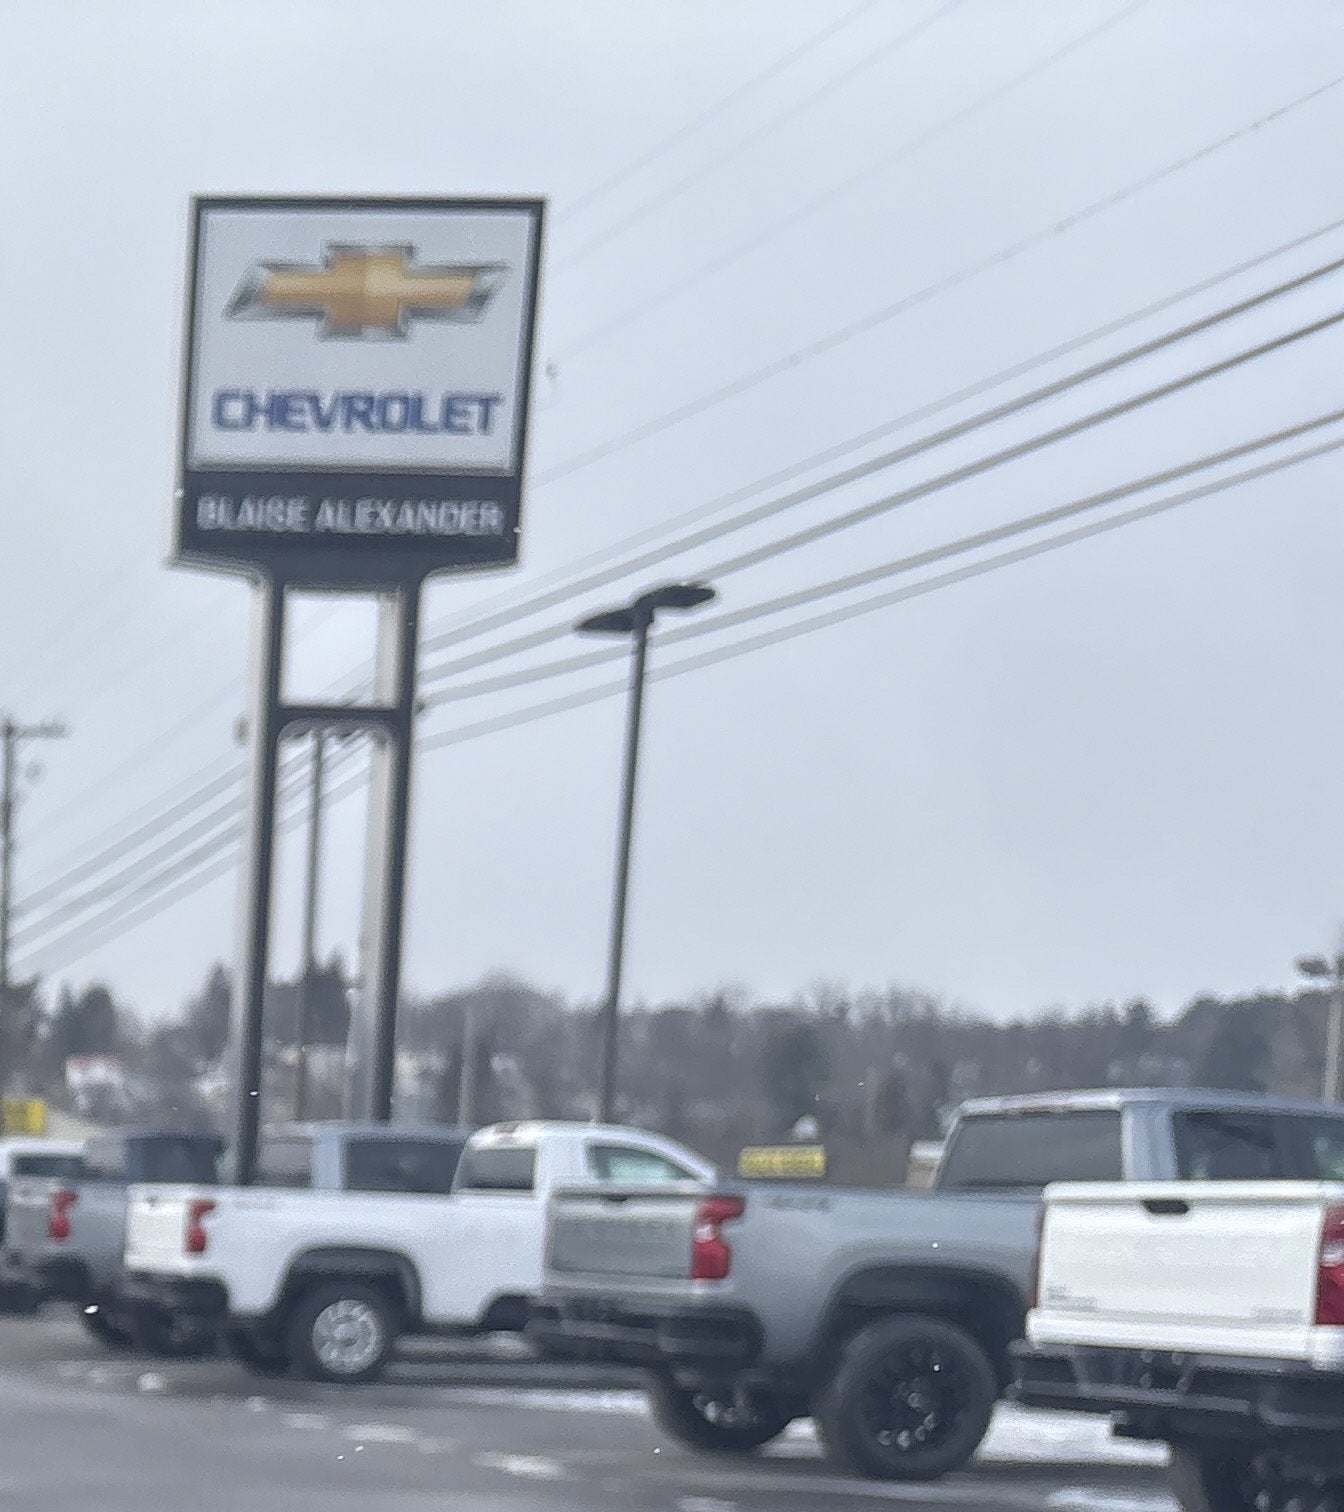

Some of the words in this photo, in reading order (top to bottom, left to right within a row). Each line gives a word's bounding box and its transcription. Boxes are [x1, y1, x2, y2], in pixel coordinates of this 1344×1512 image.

[214, 388, 502, 434] CHEVROLET
[197, 496, 309, 531] BLAISE
[315, 497, 504, 536] ALEXANDER
